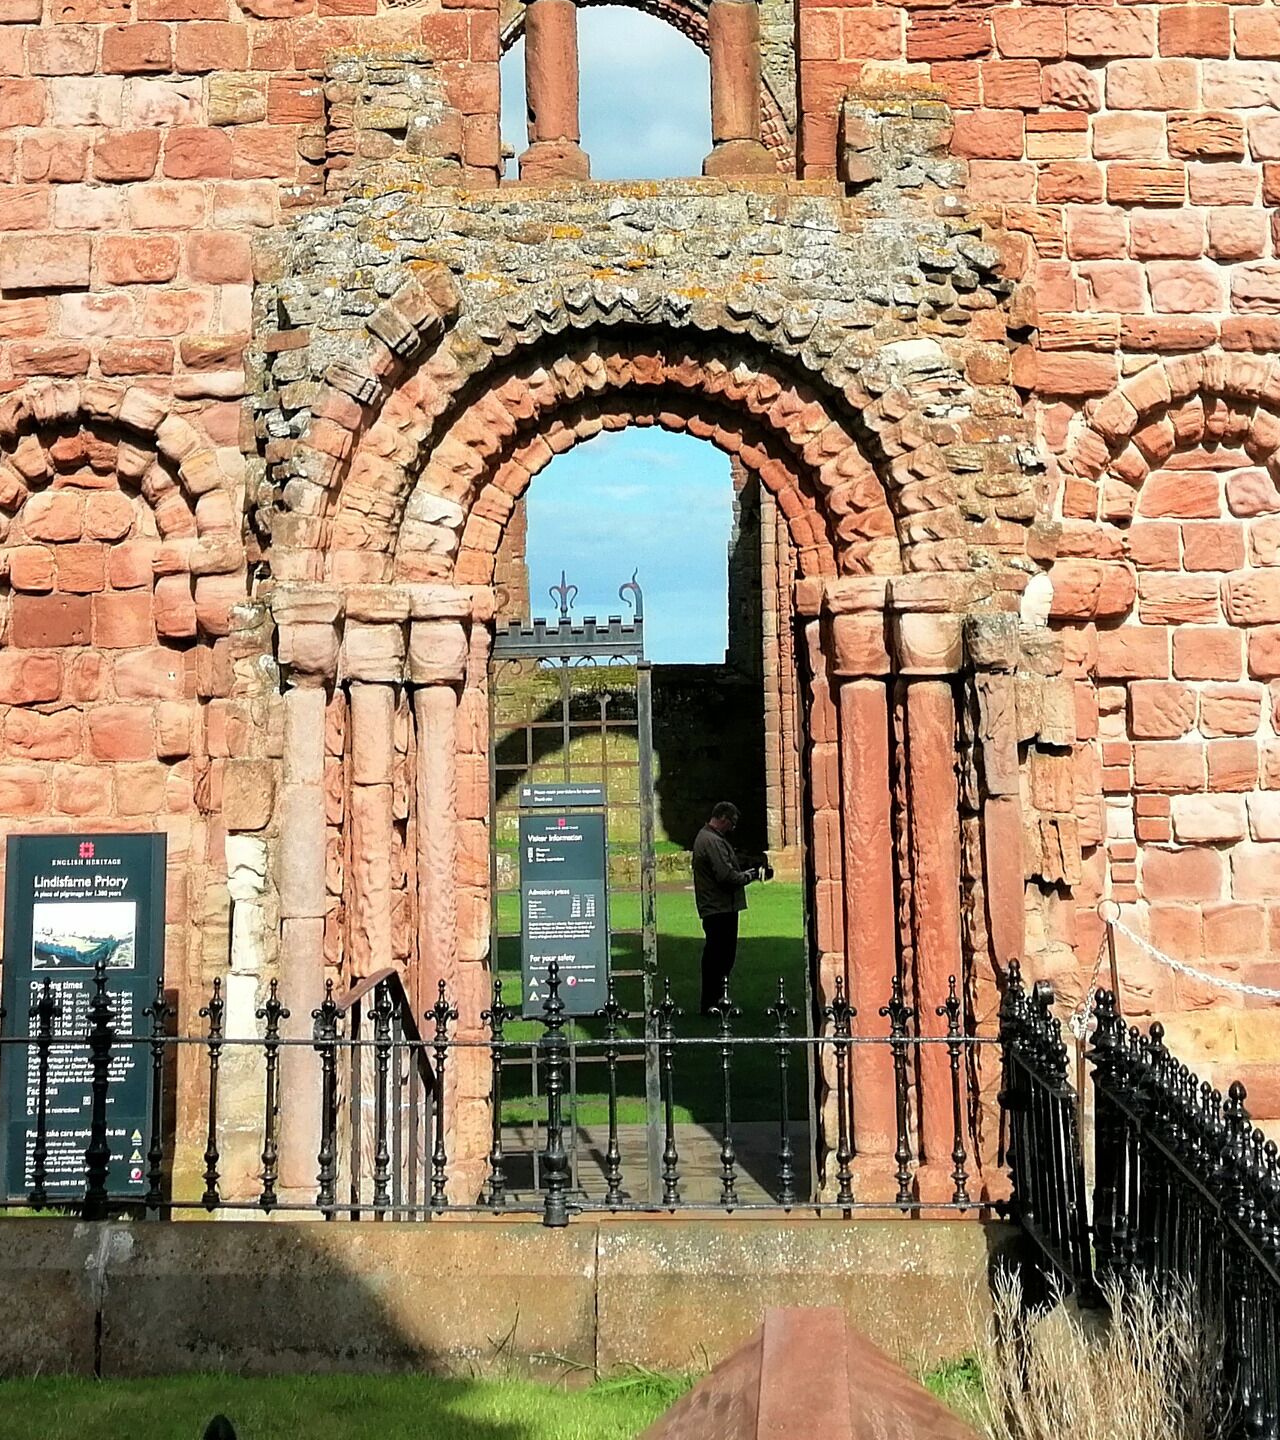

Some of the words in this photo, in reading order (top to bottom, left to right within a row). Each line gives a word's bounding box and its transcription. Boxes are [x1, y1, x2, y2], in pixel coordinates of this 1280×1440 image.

[527, 834, 547, 842] Visitor
[34, 875, 92, 888] Lindisfarne
[94, 874, 128, 890] Priory
[529, 954, 541, 962] For
[558, 953, 575, 962] safety
[30, 981, 62, 991] Oping
[63, 981, 83, 990] times
